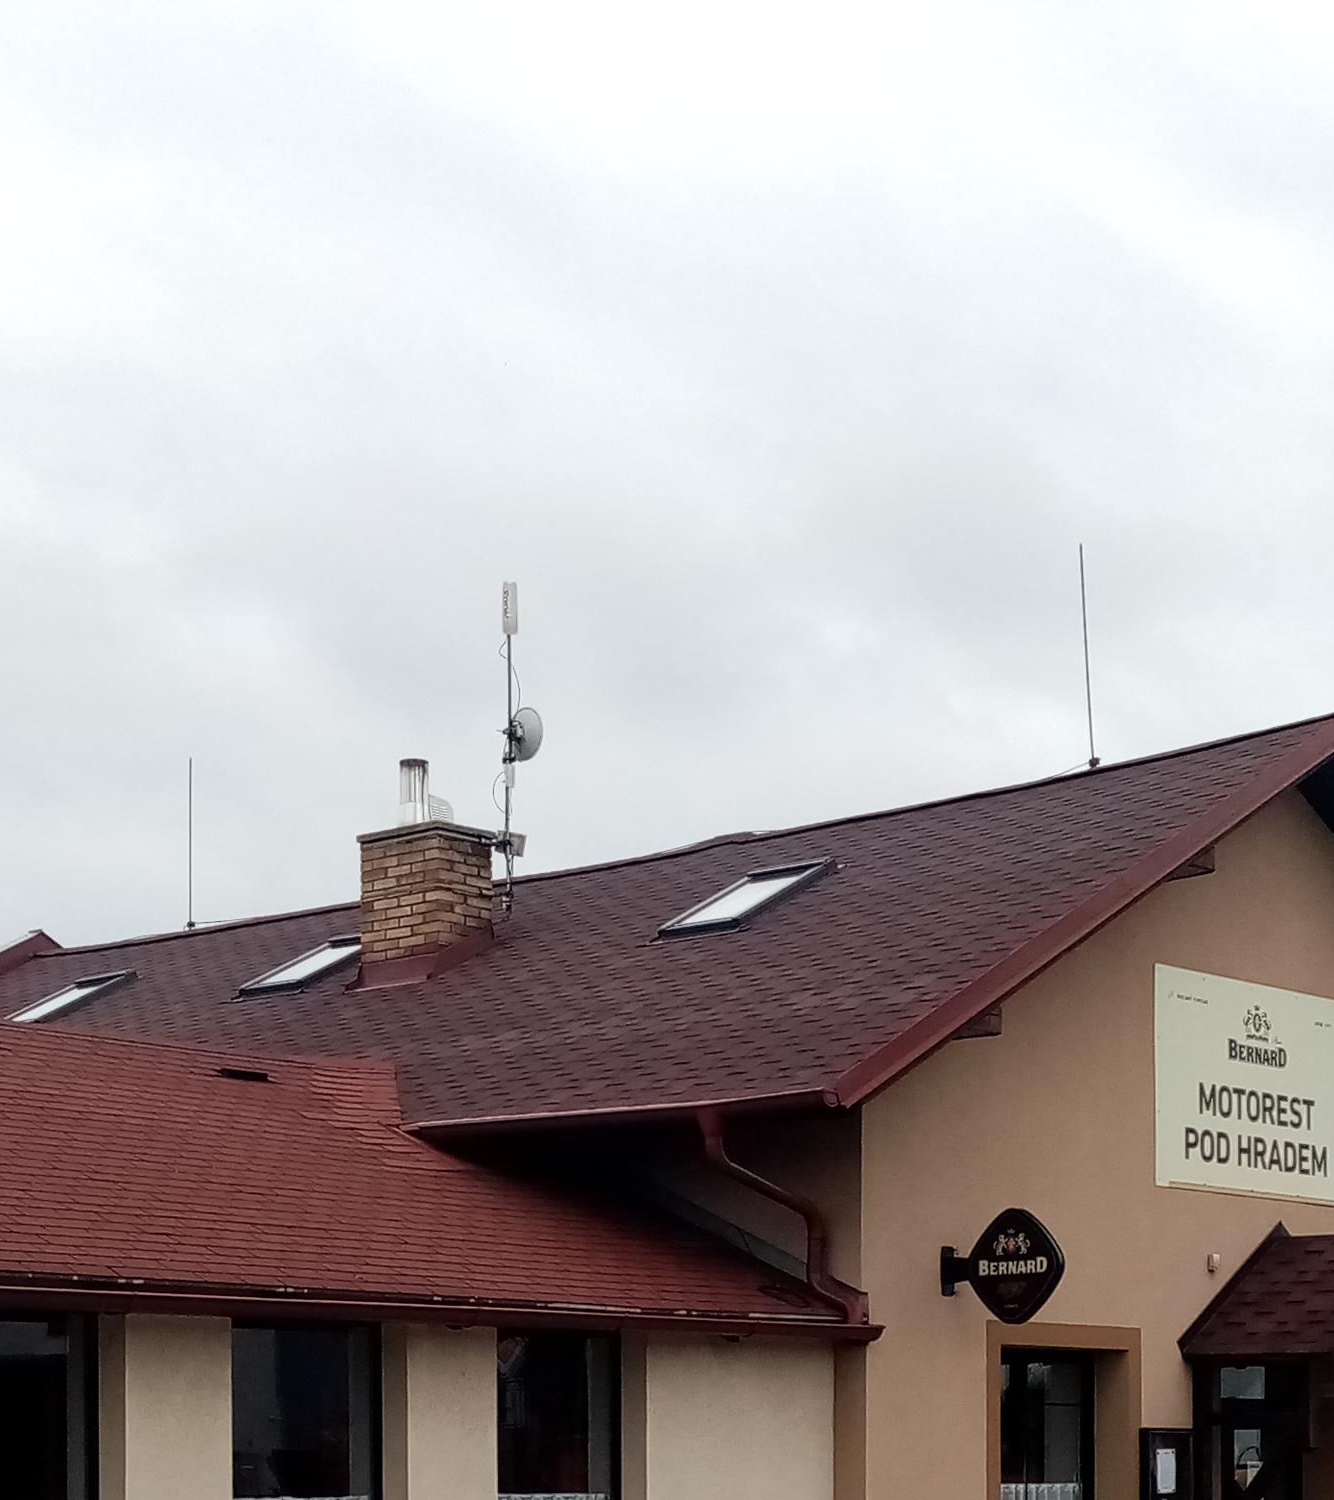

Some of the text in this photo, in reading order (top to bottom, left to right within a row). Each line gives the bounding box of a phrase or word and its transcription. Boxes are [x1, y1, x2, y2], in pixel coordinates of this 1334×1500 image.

[1228, 1038, 1287, 1068] BERNARD
[1198, 1082, 1315, 1130] MOTOREST
[1184, 1127, 1328, 1177] POD HRADEM
[978, 1256, 1048, 1276] BERNARD
